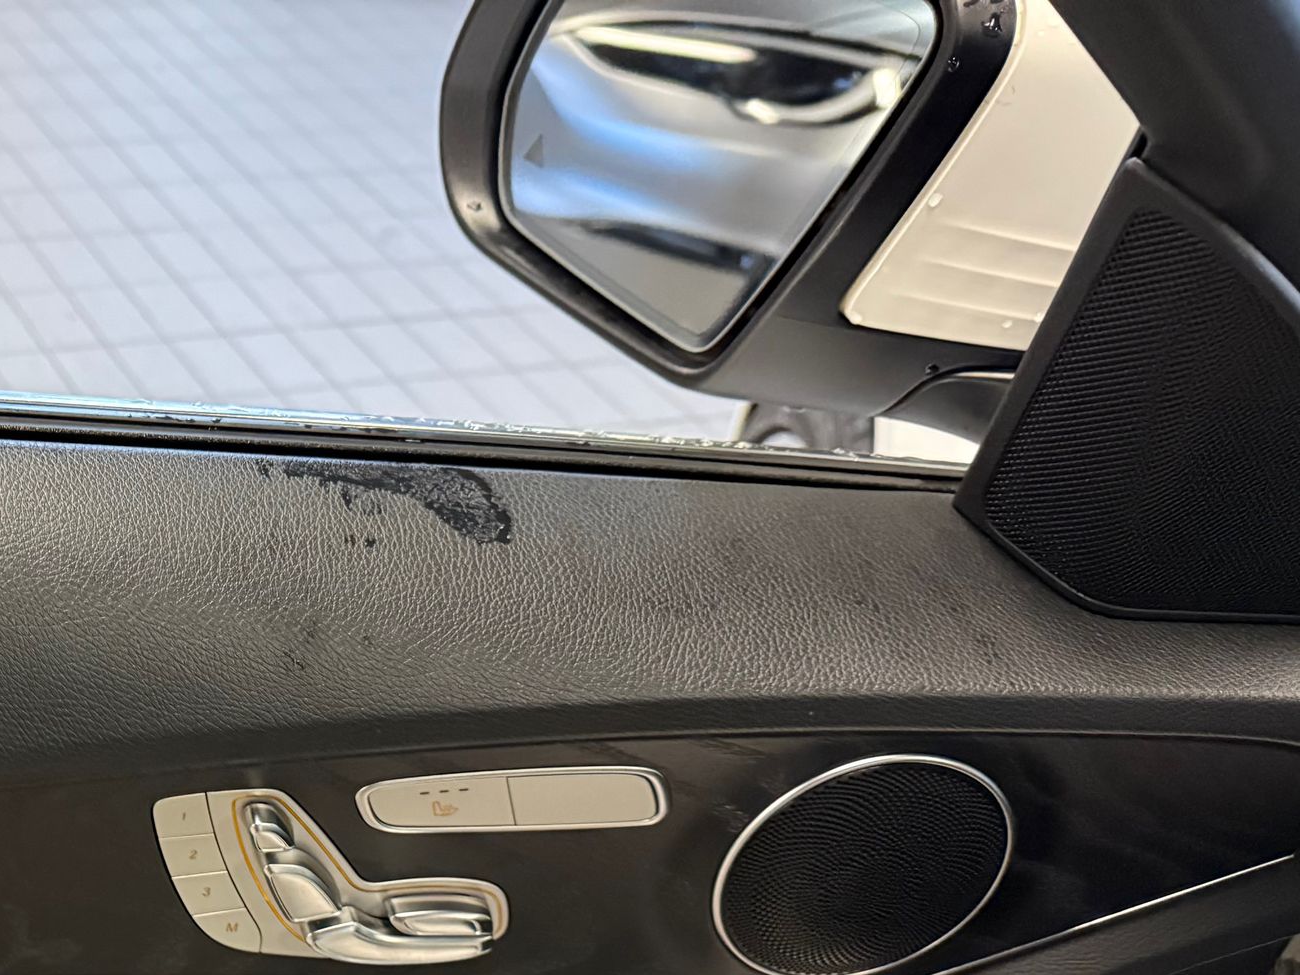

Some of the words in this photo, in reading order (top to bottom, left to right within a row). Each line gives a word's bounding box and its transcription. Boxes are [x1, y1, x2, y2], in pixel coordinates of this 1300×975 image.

[188, 849, 198, 860] 2
[201, 886, 212, 898] 3
[225, 922, 239, 933] M
